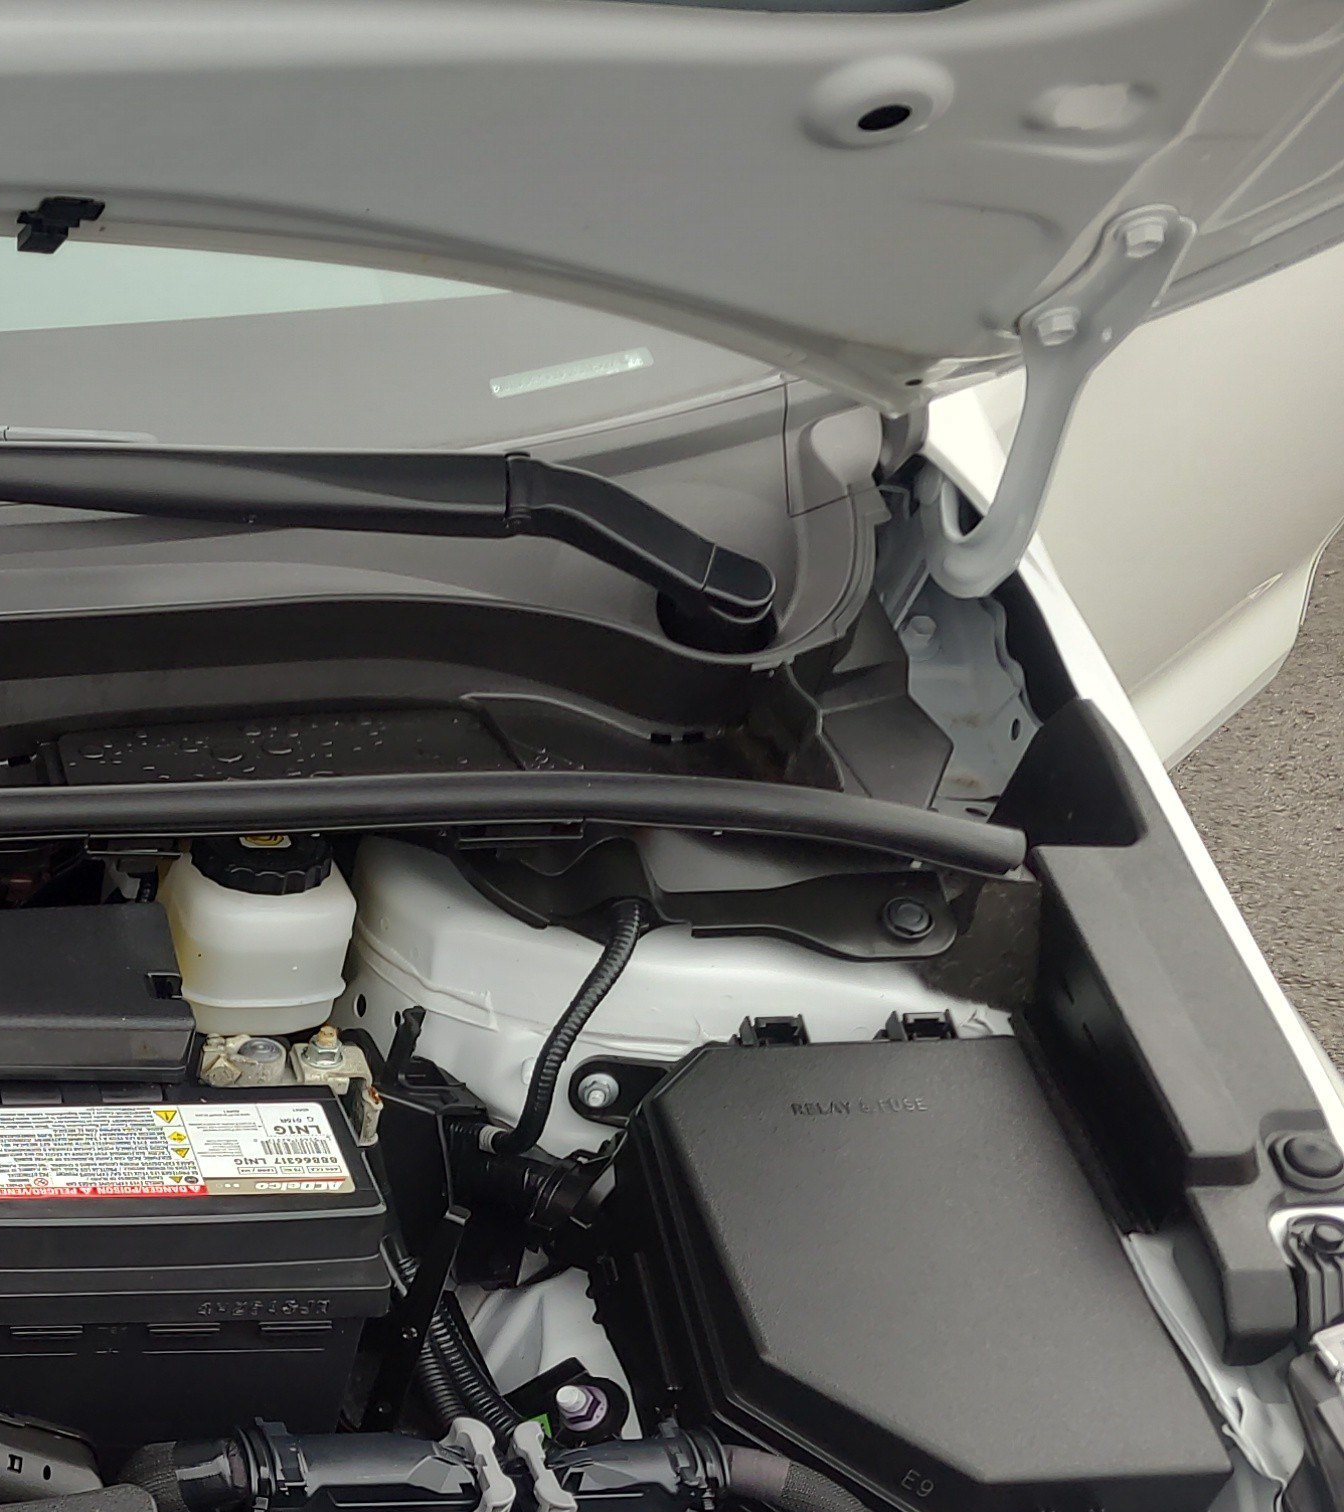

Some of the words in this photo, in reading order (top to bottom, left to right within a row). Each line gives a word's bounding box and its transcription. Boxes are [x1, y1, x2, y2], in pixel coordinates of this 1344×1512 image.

[790, 1101, 850, 1115] RELAY
[878, 1097, 928, 1113] FUSE
[273, 1124, 322, 1136] LN1G
[233, 1157, 267, 1166] LN1G
[96, 1185, 188, 1196] DANGER/POISON
[254, 1181, 343, 1192] ACDelco
[900, 1468, 936, 1498] E9
